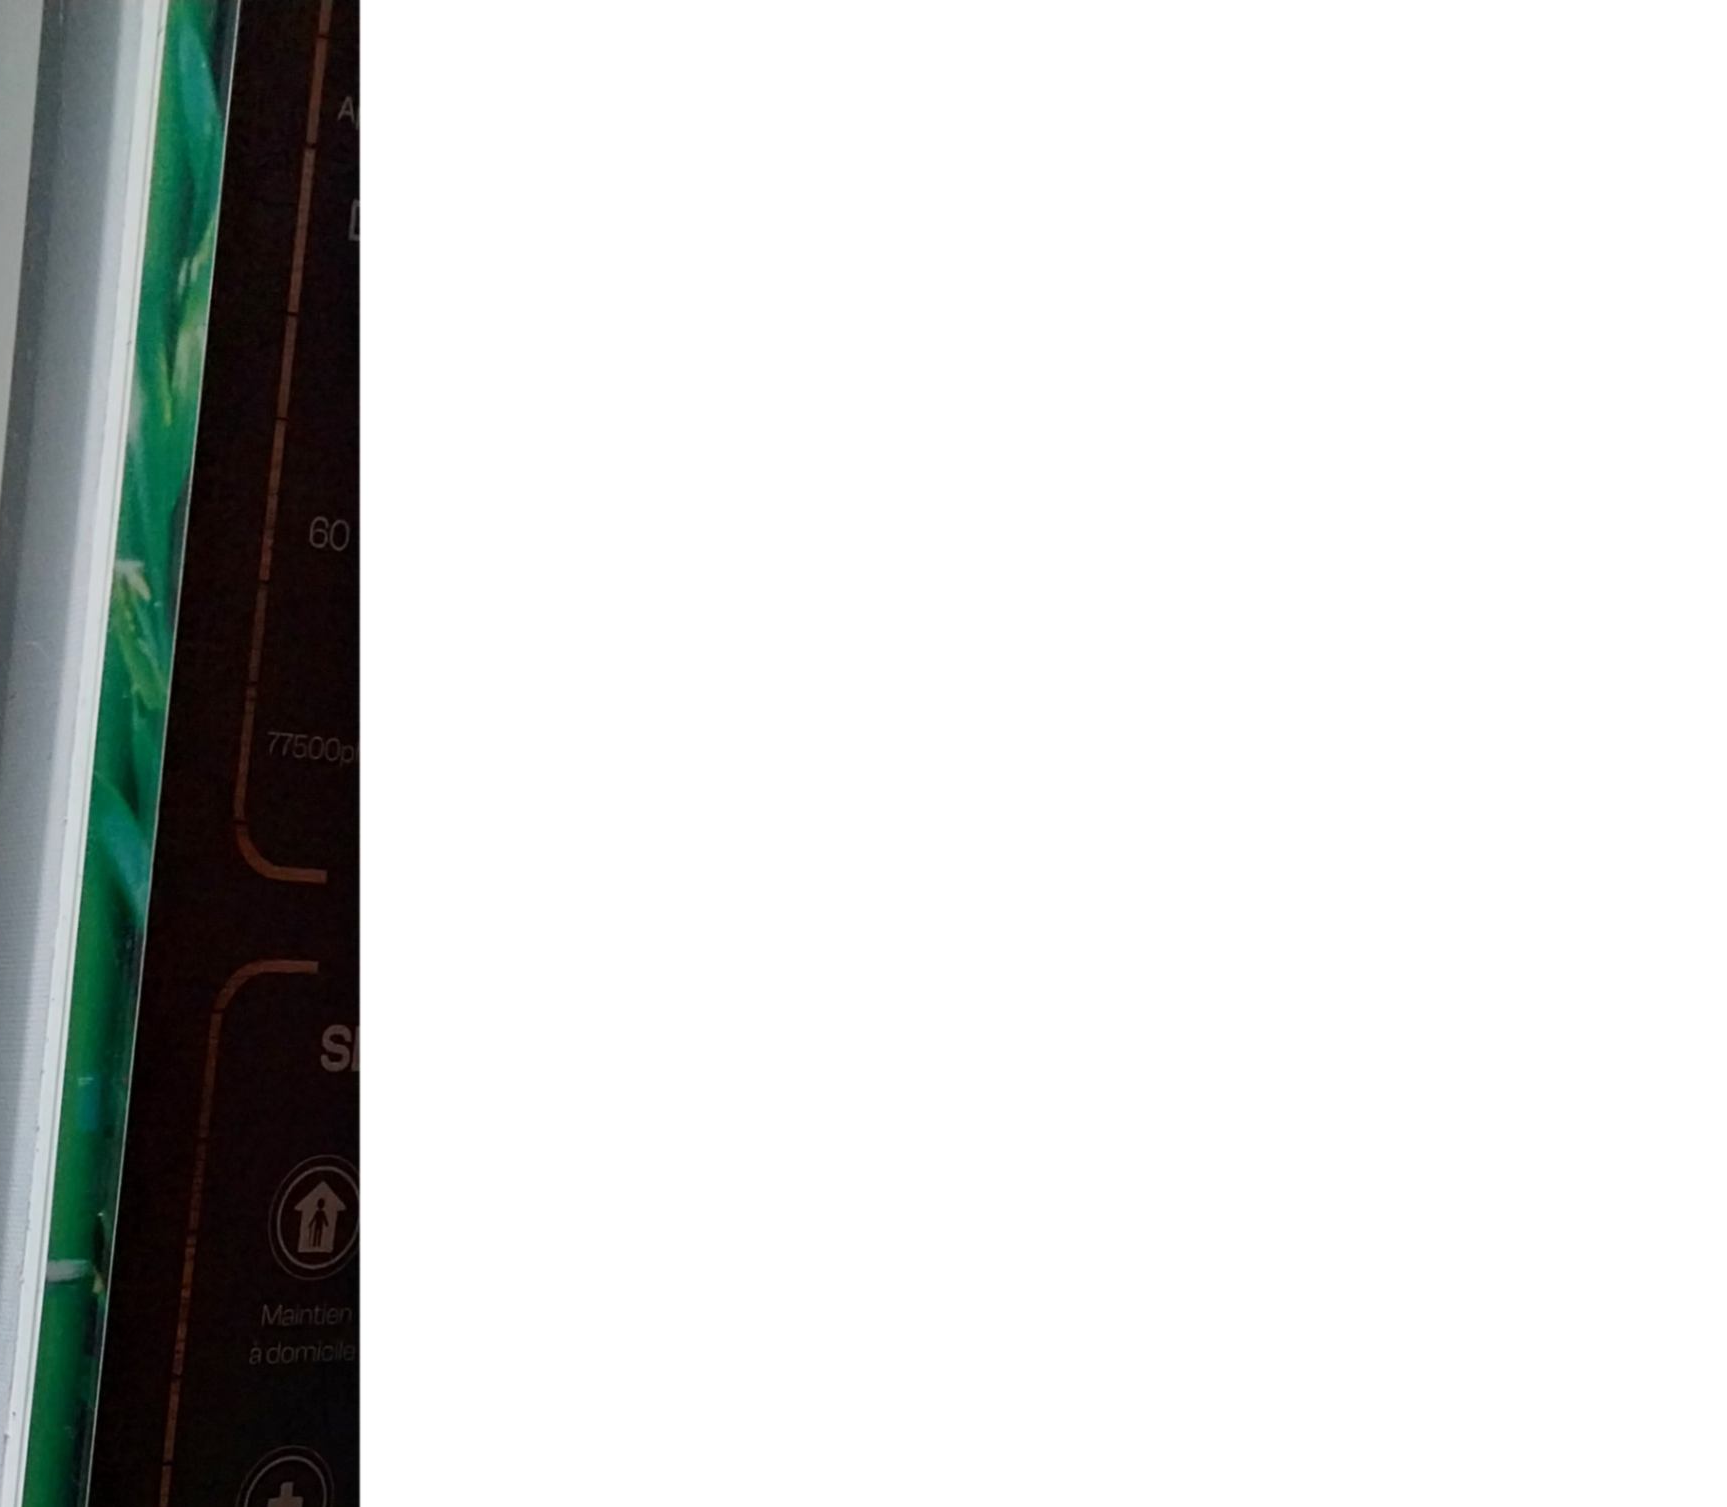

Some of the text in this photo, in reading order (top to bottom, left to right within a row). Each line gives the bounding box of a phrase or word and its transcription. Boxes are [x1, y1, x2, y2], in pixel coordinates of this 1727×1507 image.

[309, 515, 350, 551] 60
[261, 1303, 353, 1327] Maintien
[265, 1341, 356, 1365] domicile
